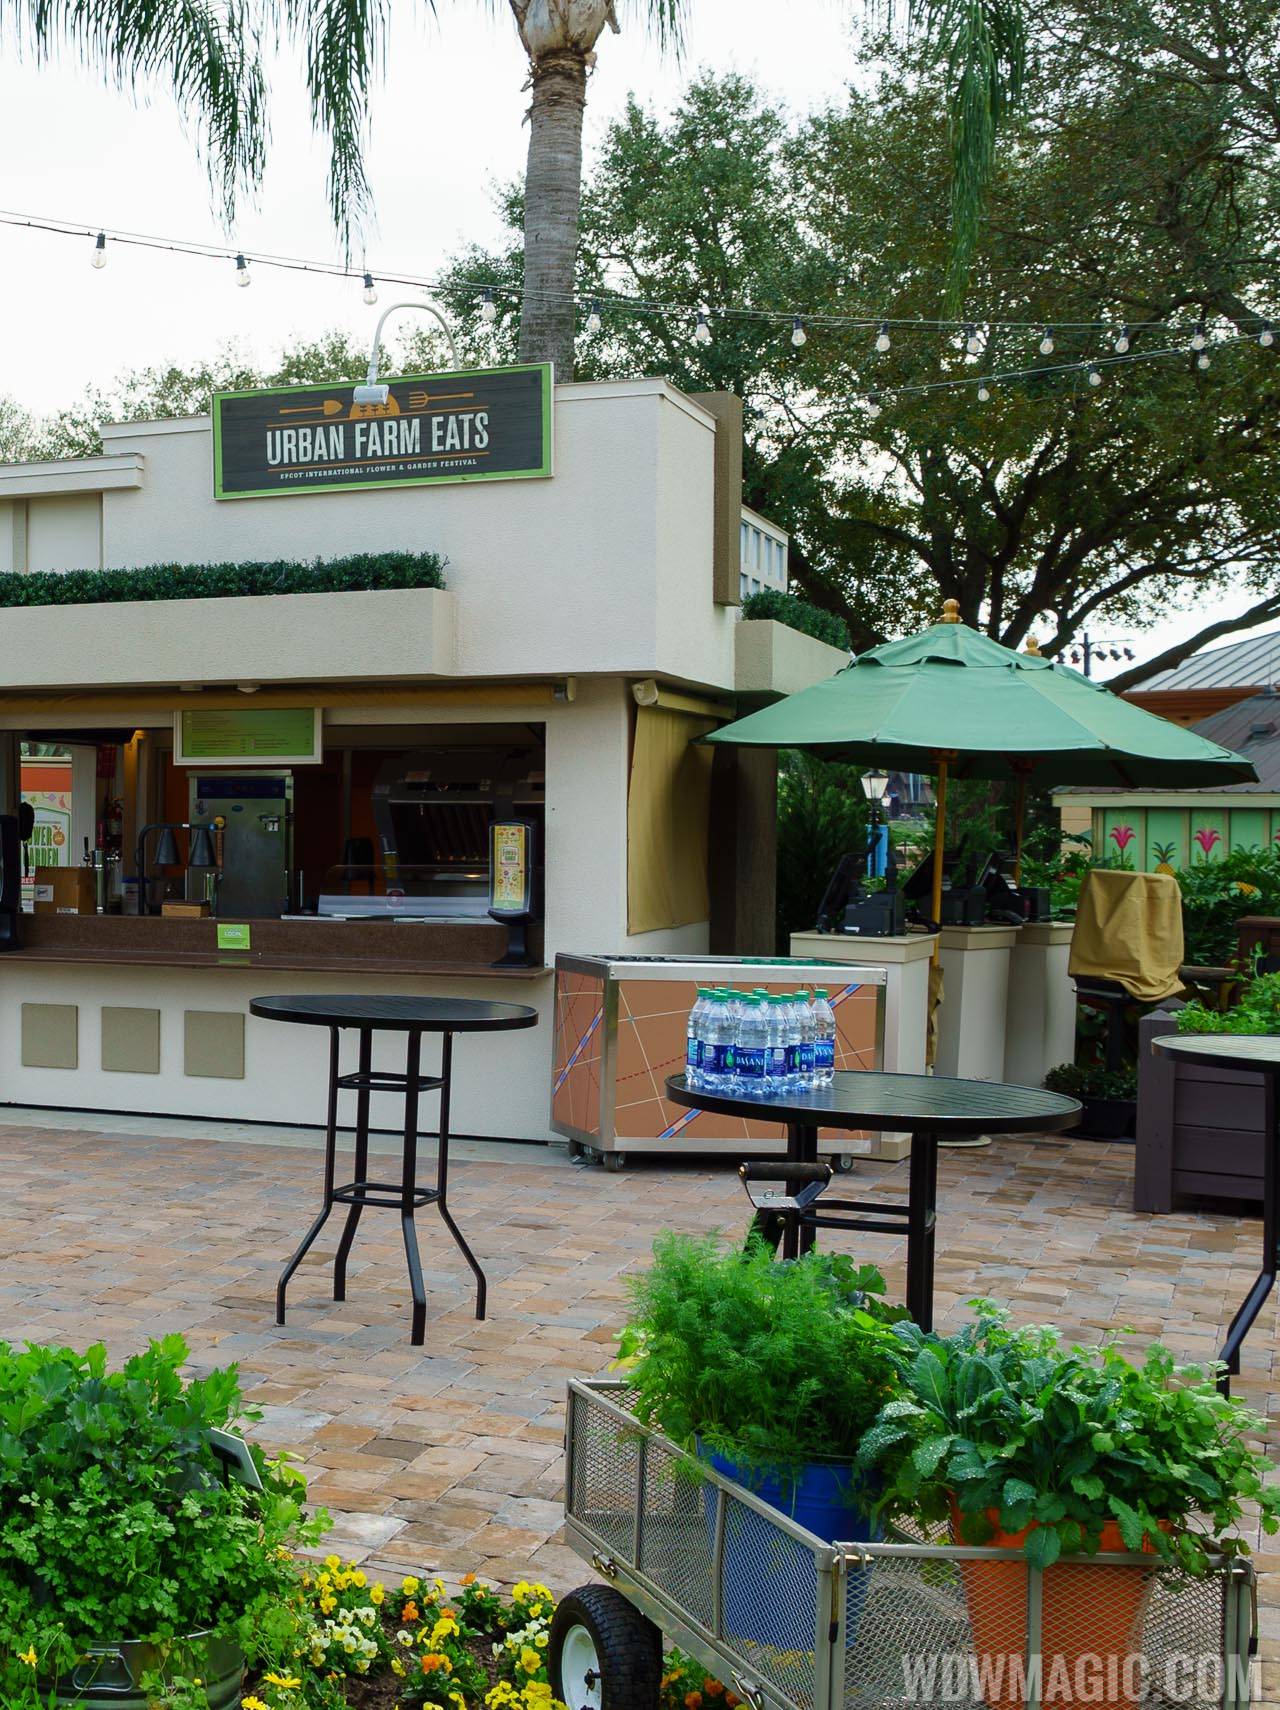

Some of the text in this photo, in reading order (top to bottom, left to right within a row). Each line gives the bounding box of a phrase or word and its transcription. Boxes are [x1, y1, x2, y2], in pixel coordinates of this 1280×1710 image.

[266, 412, 489, 465] URBAN FARM EATS
[280, 472, 304, 480] EPCOT
[306, 467, 364, 478] INTERNATIONAL
[366, 464, 396, 473] FLOWER
[407, 461, 437, 470] GARDEN
[440, 458, 478, 468] FESTIVAL
[736, 1056, 764, 1067] DASANI
